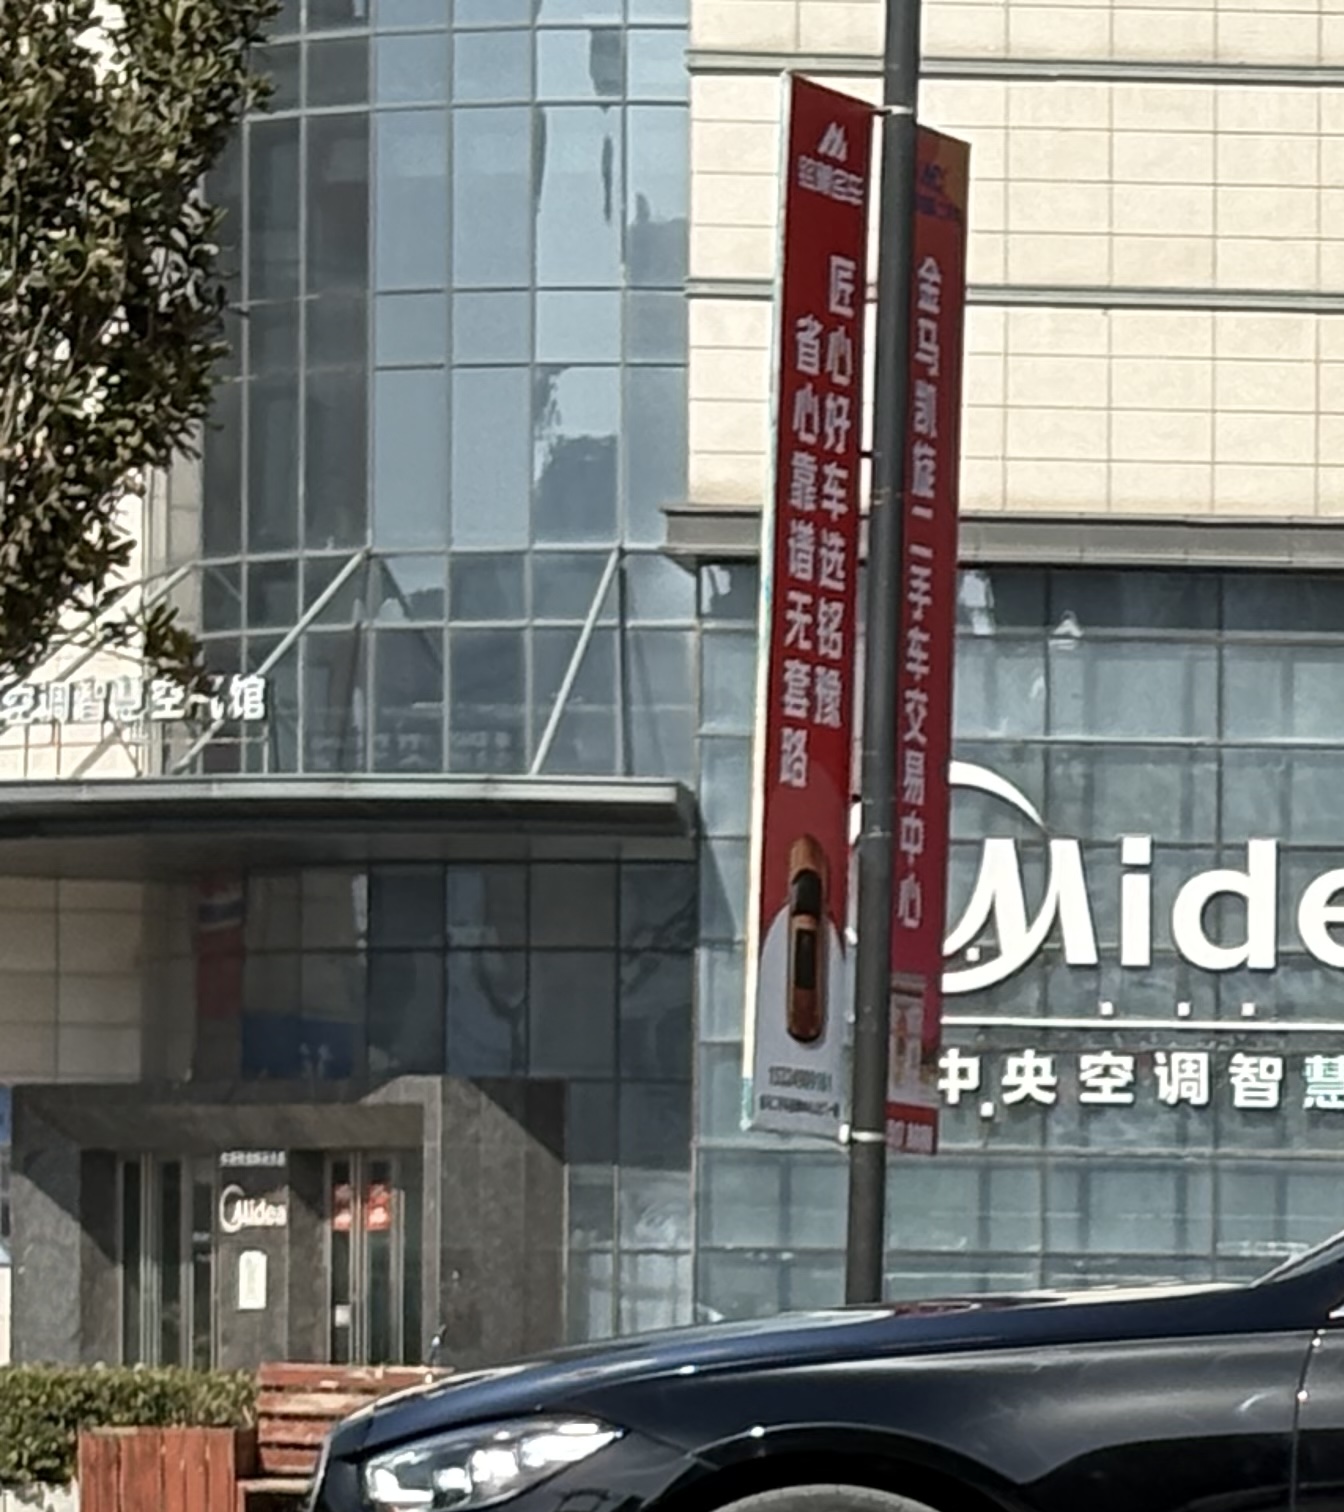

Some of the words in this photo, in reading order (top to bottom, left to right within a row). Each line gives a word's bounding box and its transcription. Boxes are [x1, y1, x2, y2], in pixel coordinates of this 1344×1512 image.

[779, 313, 824, 788] 省心靠谱无套路
[219, 1184, 288, 1234] Midea
